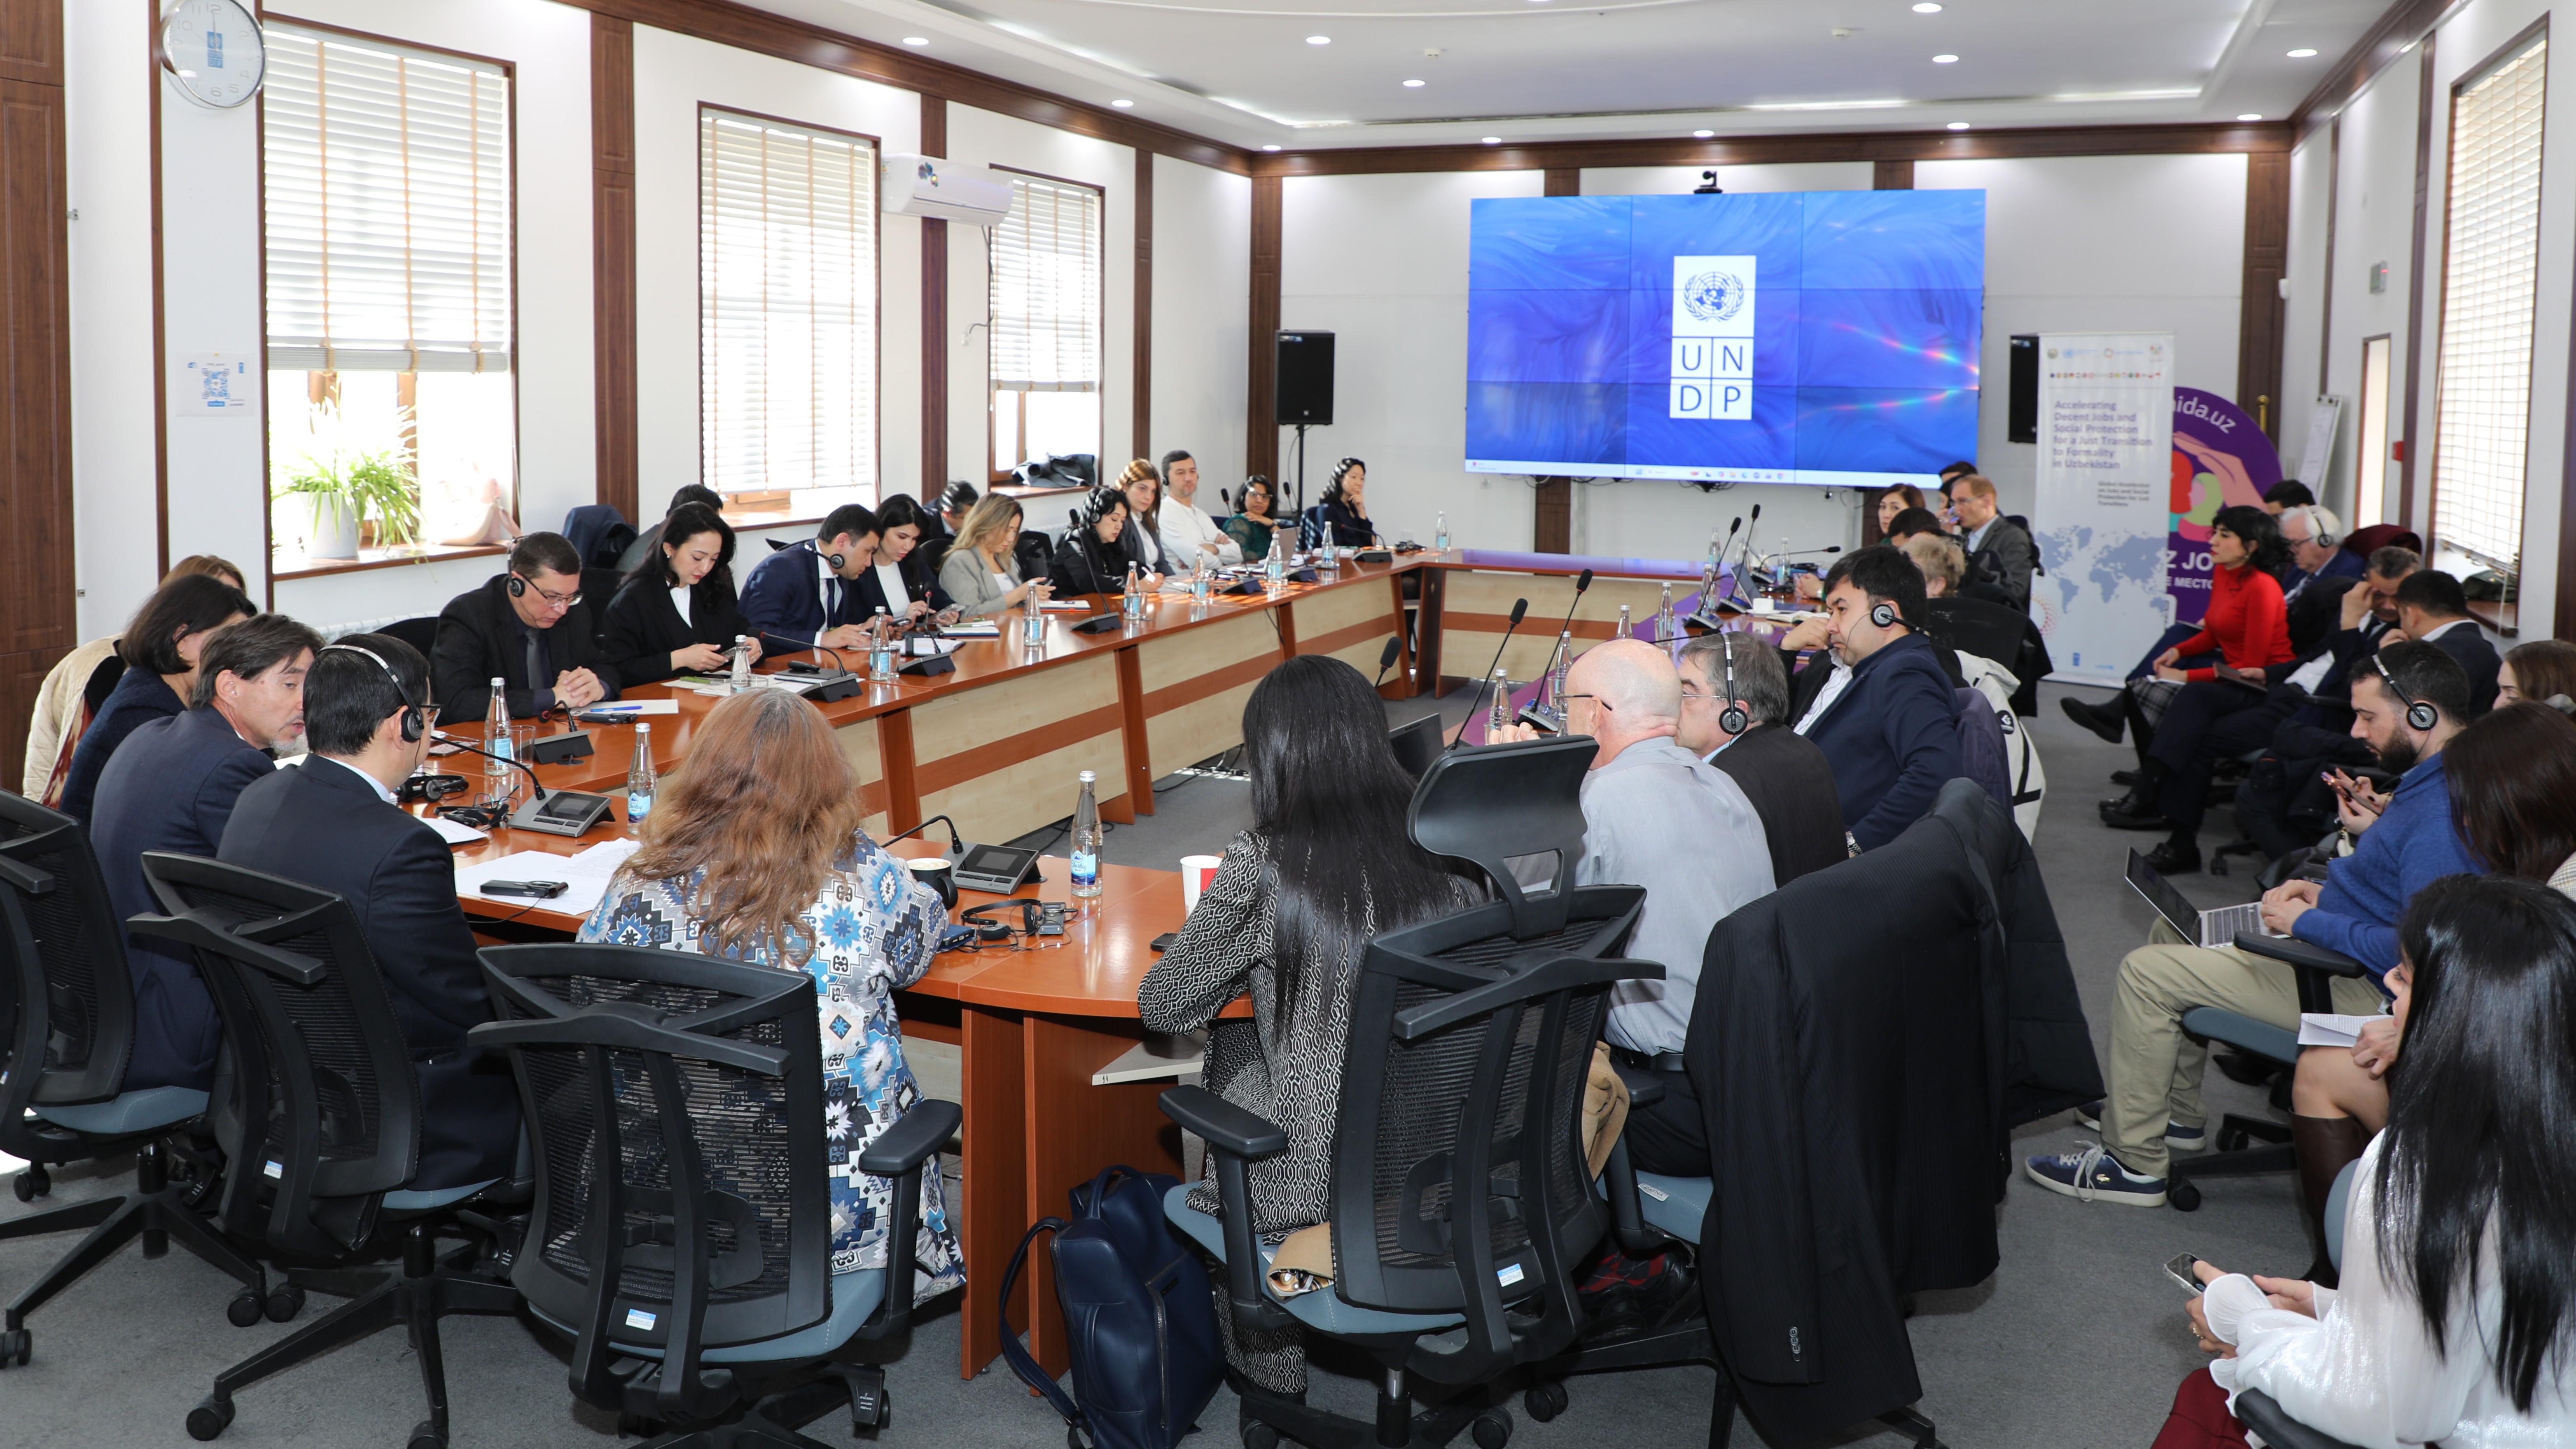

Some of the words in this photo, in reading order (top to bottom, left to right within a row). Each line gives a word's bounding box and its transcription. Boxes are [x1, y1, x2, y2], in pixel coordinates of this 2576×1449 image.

[206, 3, 221, 15] 12
[177, 19, 193, 31] 10
[238, 30, 250, 40] 2
[172, 39, 184, 50] 9
[244, 51, 255, 61] 3
[240, 70, 251, 79] 4
[210, 87, 222, 97] 6
[229, 84, 239, 93] 5
[2055, 401, 2117, 411] Accelerating
[2055, 412, 2089, 421] Decent
[2092, 413, 2114, 421] Jobs
[2117, 413, 2136, 422] and
[2174, 396, 2237, 434] ida.uz
[2054, 424, 2083, 432] Social
[2086, 424, 2138, 433] Protection
[2053, 435, 2067, 444] for
[2102, 436, 2153, 446] Transition
[2066, 447, 2114, 458] Formality
[2053, 459, 2062, 467] in
[2065, 460, 2121, 469] Uzbekistan
